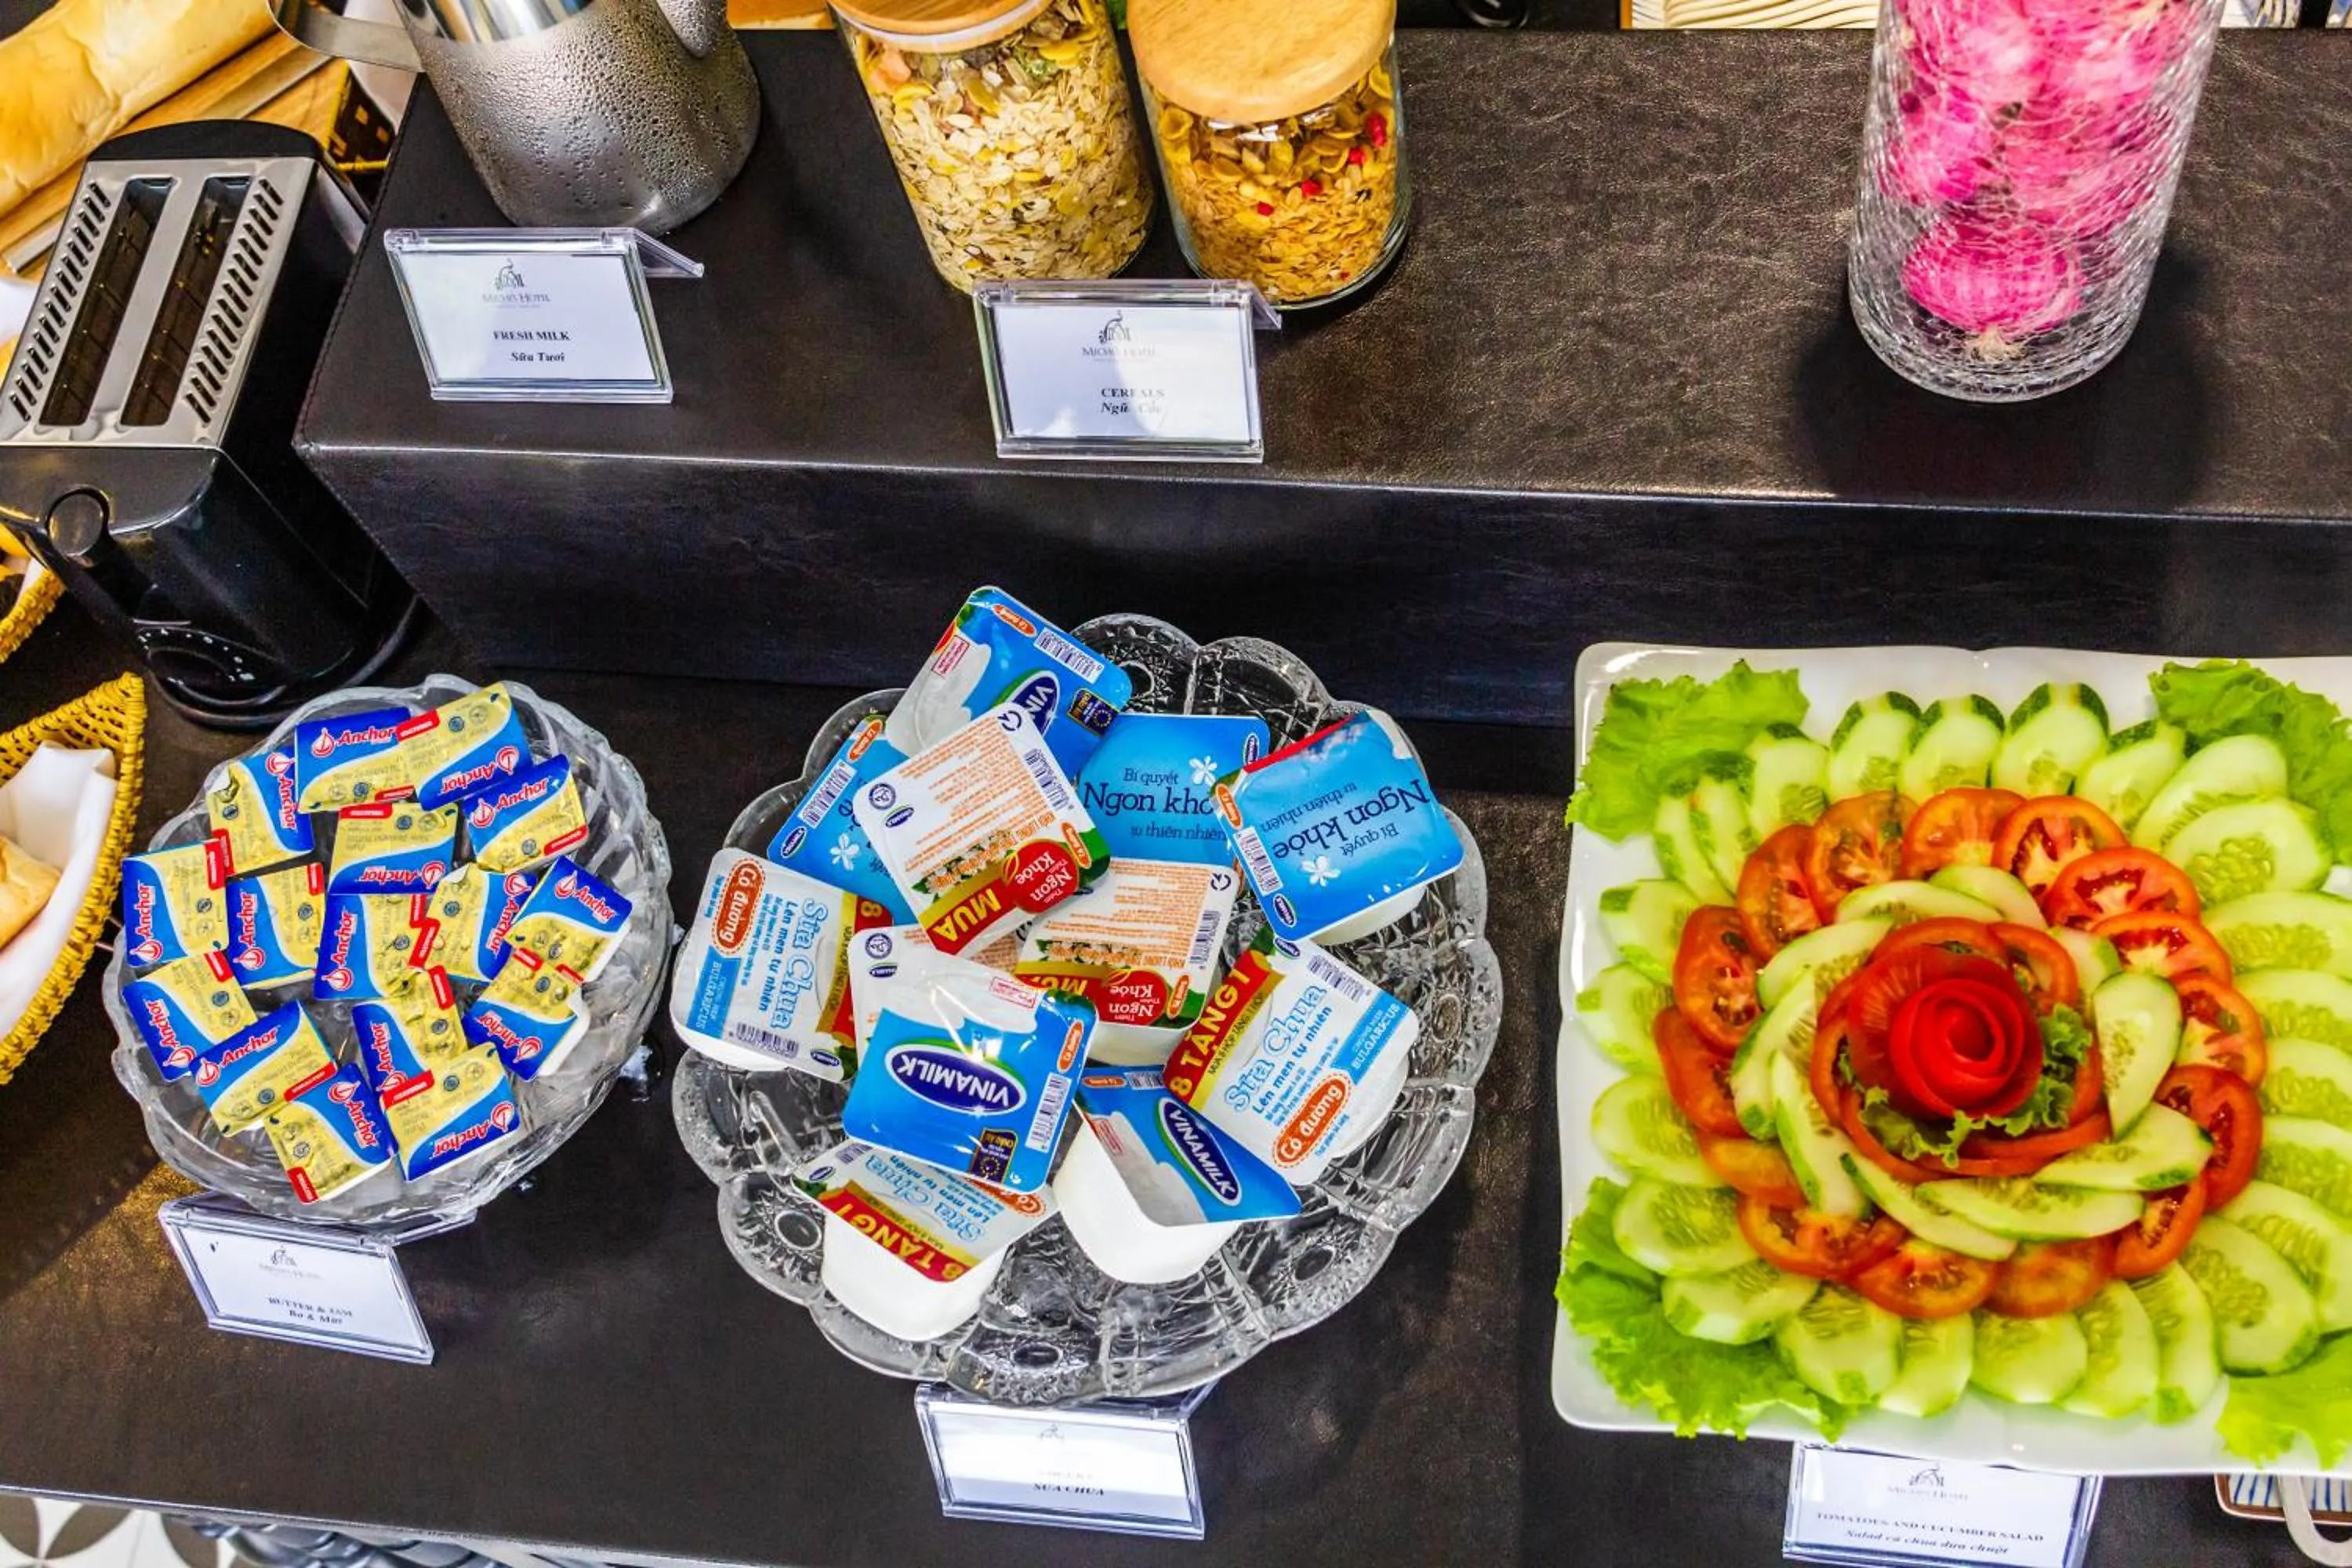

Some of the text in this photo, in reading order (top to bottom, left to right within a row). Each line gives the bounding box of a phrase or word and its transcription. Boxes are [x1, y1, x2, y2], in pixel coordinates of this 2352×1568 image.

[493, 330, 570, 340] FRESH MILK
[337, 726, 395, 746] Anchor
[441, 760, 496, 793] Anchor
[495, 778, 549, 810] Anchor
[278, 775, 298, 829] Anchor
[1083, 782, 1156, 816] Ngon
[1345, 779, 1432, 825] Ngon
[359, 866, 425, 884] Anchor
[1031, 866, 1073, 902] Ngon
[134, 880, 154, 938] Anchor
[238, 890, 257, 946] Anchor
[575, 887, 619, 922] Anchor
[860, 901, 883, 918] 8
[933, 887, 1002, 942] MUA
[332, 909, 357, 966] Anchor
[484, 900, 521, 956] Anchor
[775, 930, 788, 955] men
[770, 954, 815, 1030] Chua
[1033, 976, 1088, 996] MU
[145, 997, 179, 1047] Anchor
[1108, 1002, 1155, 1018] Ngon
[1262, 985, 1327, 1057] Chua
[220, 1026, 279, 1067] Anchor
[370, 1022, 394, 1073] Anchor
[478, 1011, 522, 1049] Anchor
[897, 1054, 1011, 1108] VINAMILK
[1169, 1075, 1194, 1098] 8
[1273, 1059, 1294, 1089] men
[346, 1100, 379, 1149] Anchor
[434, 1121, 491, 1156] Anchor
[1168, 1109, 1236, 1196] VINAMILK
[941, 1263, 965, 1282] 8
[1846, 1529, 1884, 1541] Salad
